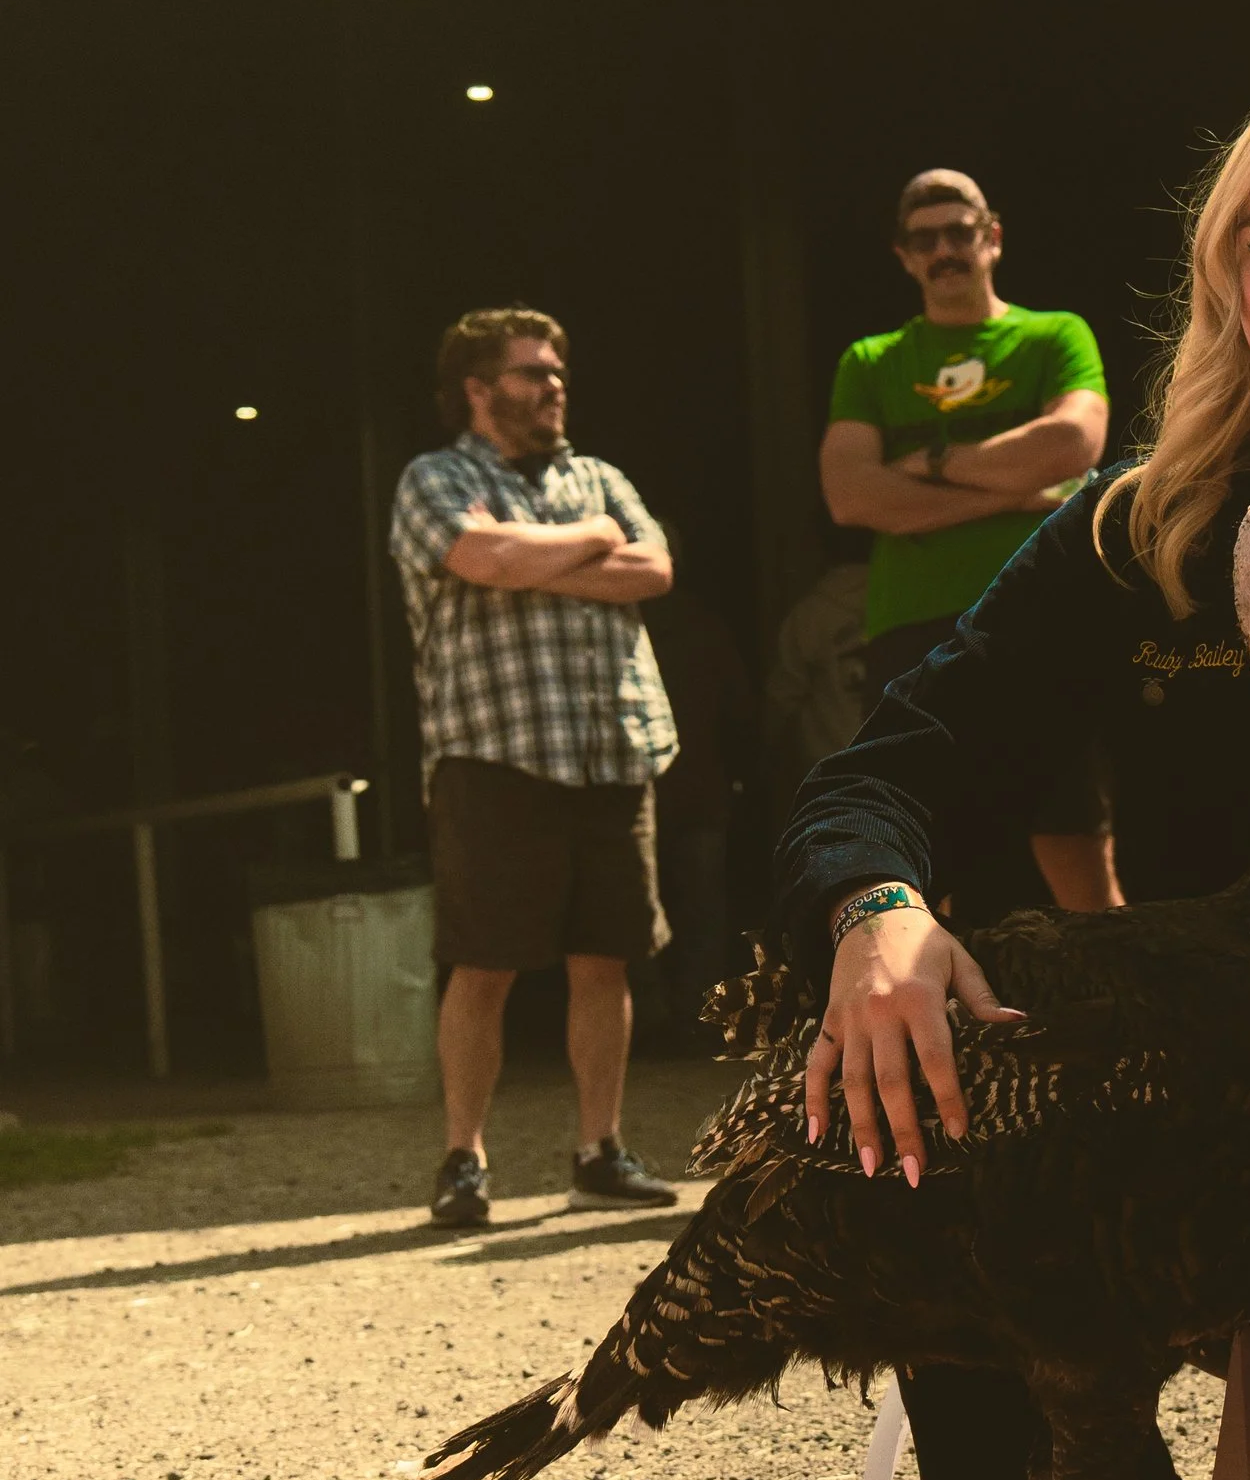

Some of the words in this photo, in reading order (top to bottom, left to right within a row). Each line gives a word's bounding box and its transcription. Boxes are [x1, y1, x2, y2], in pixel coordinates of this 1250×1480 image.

[1132, 640, 1184, 678] Ruby
[1188, 639, 1245, 678] Bailey
[847, 886, 899, 913] COUNTY
[840, 909, 866, 934] 2026
